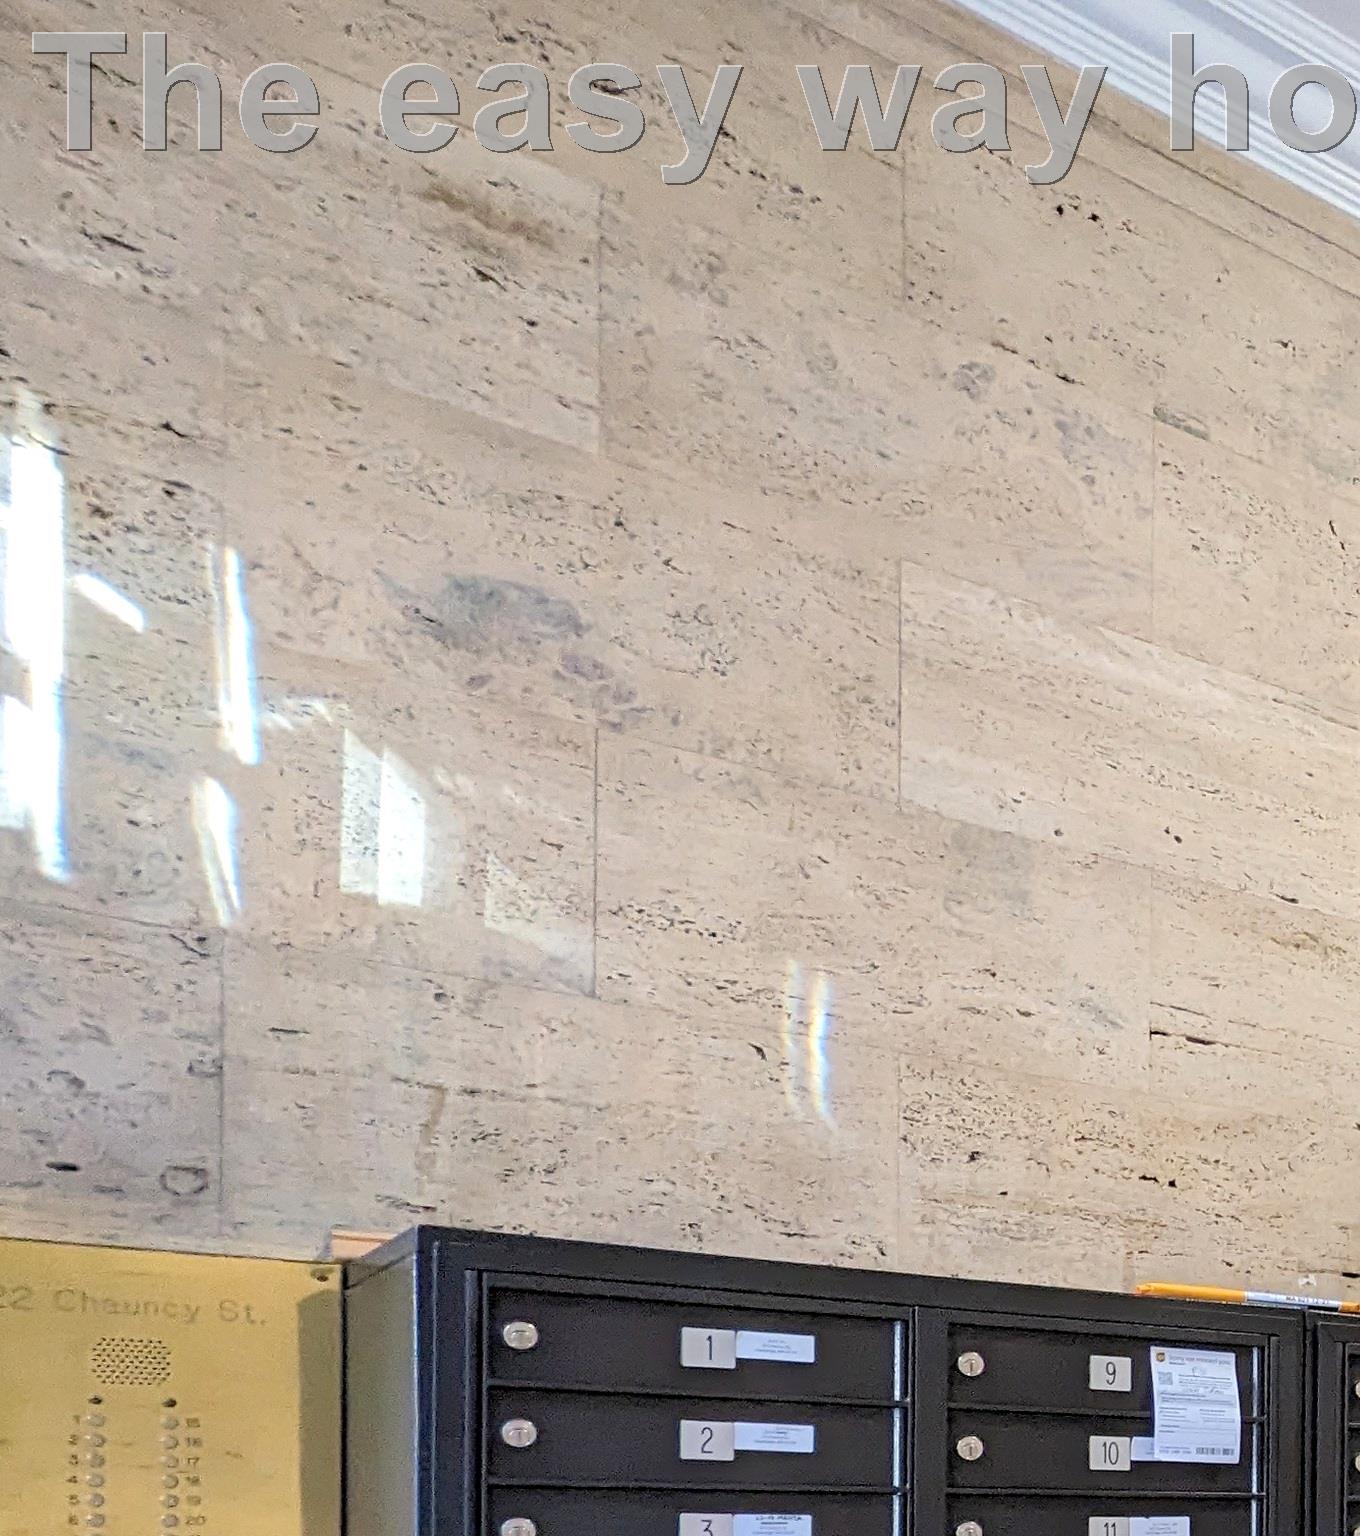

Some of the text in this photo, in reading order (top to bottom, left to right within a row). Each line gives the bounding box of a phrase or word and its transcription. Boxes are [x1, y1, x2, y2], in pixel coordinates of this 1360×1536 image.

[0, 1284, 268, 1327] 2 Chauncy St.
[706, 1335, 713, 1361] 1
[1106, 1361, 1117, 1386] 9
[701, 1426, 713, 1454] 2
[1103, 1441, 1119, 1466] 10
[186, 1515, 206, 1526] 20
